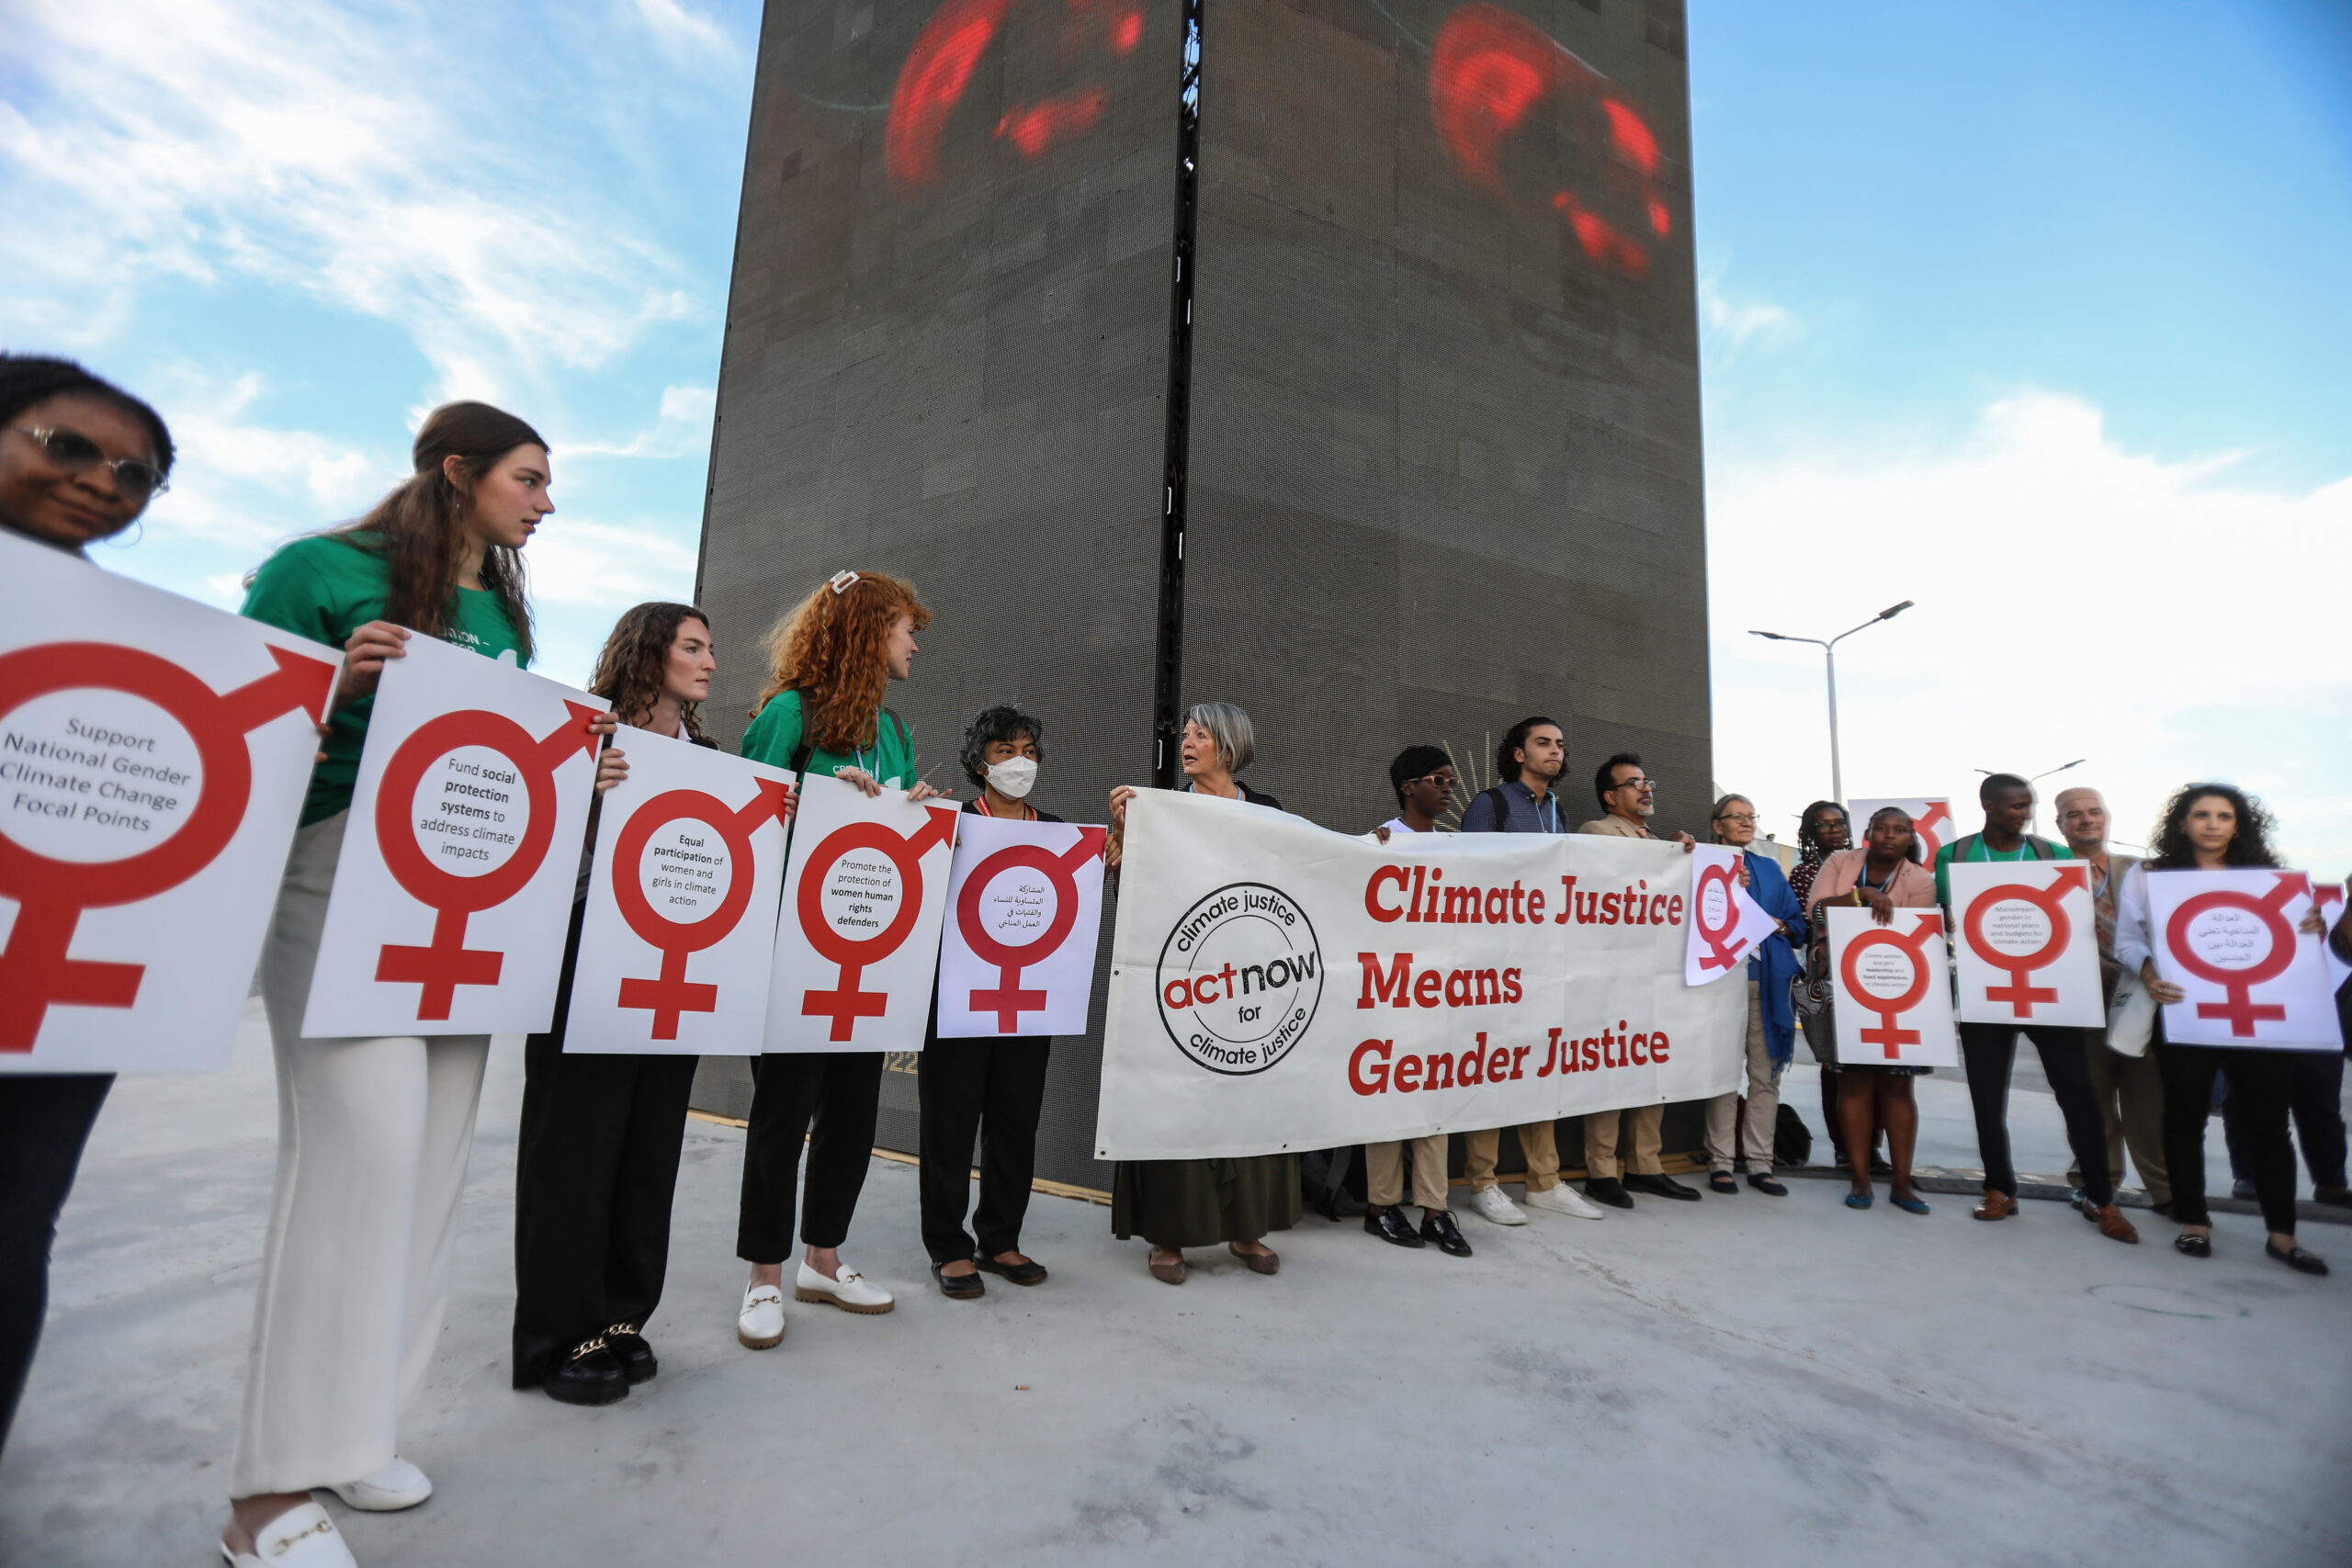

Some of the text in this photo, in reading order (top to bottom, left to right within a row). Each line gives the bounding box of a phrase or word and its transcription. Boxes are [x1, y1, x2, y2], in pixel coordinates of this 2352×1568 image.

[65, 717, 155, 753] Support
[4, 732, 190, 787] National Gender
[448, 758, 516, 785] Fund social
[0, 761, 177, 811] Climate Change
[445, 780, 509, 804] protection
[13, 793, 151, 831] Focal Points
[440, 800, 505, 823] systems to
[420, 818, 515, 845] address climate
[679, 834, 705, 848] Equal
[441, 841, 490, 861] impacts
[654, 846, 723, 866] participation of
[661, 863, 713, 879] women and
[842, 859, 892, 874] Promote the
[652, 876, 717, 895] girls in climate
[838, 874, 892, 887] protection of
[1019, 885, 1045, 895] المشاركة
[669, 896, 697, 907] action
[831, 888, 893, 901] women human
[1014, 897, 1044, 907] المتساوية
[1365, 864, 1683, 926] Climate Justice
[848, 903, 873, 914] rights
[1006, 907, 1042, 919] والفتيات في
[837, 916, 879, 928] defenders
[998, 919, 1040, 930] العمل المناخي
[1177, 890, 1296, 953] climate justice
[1356, 952, 1522, 1010] Means
[1238, 1006, 1261, 1024] for
[1190, 1007, 1306, 1065] climate justice
[883, 1051, 918, 1074] 22
[1348, 1020, 1671, 1096] Gender Justice
